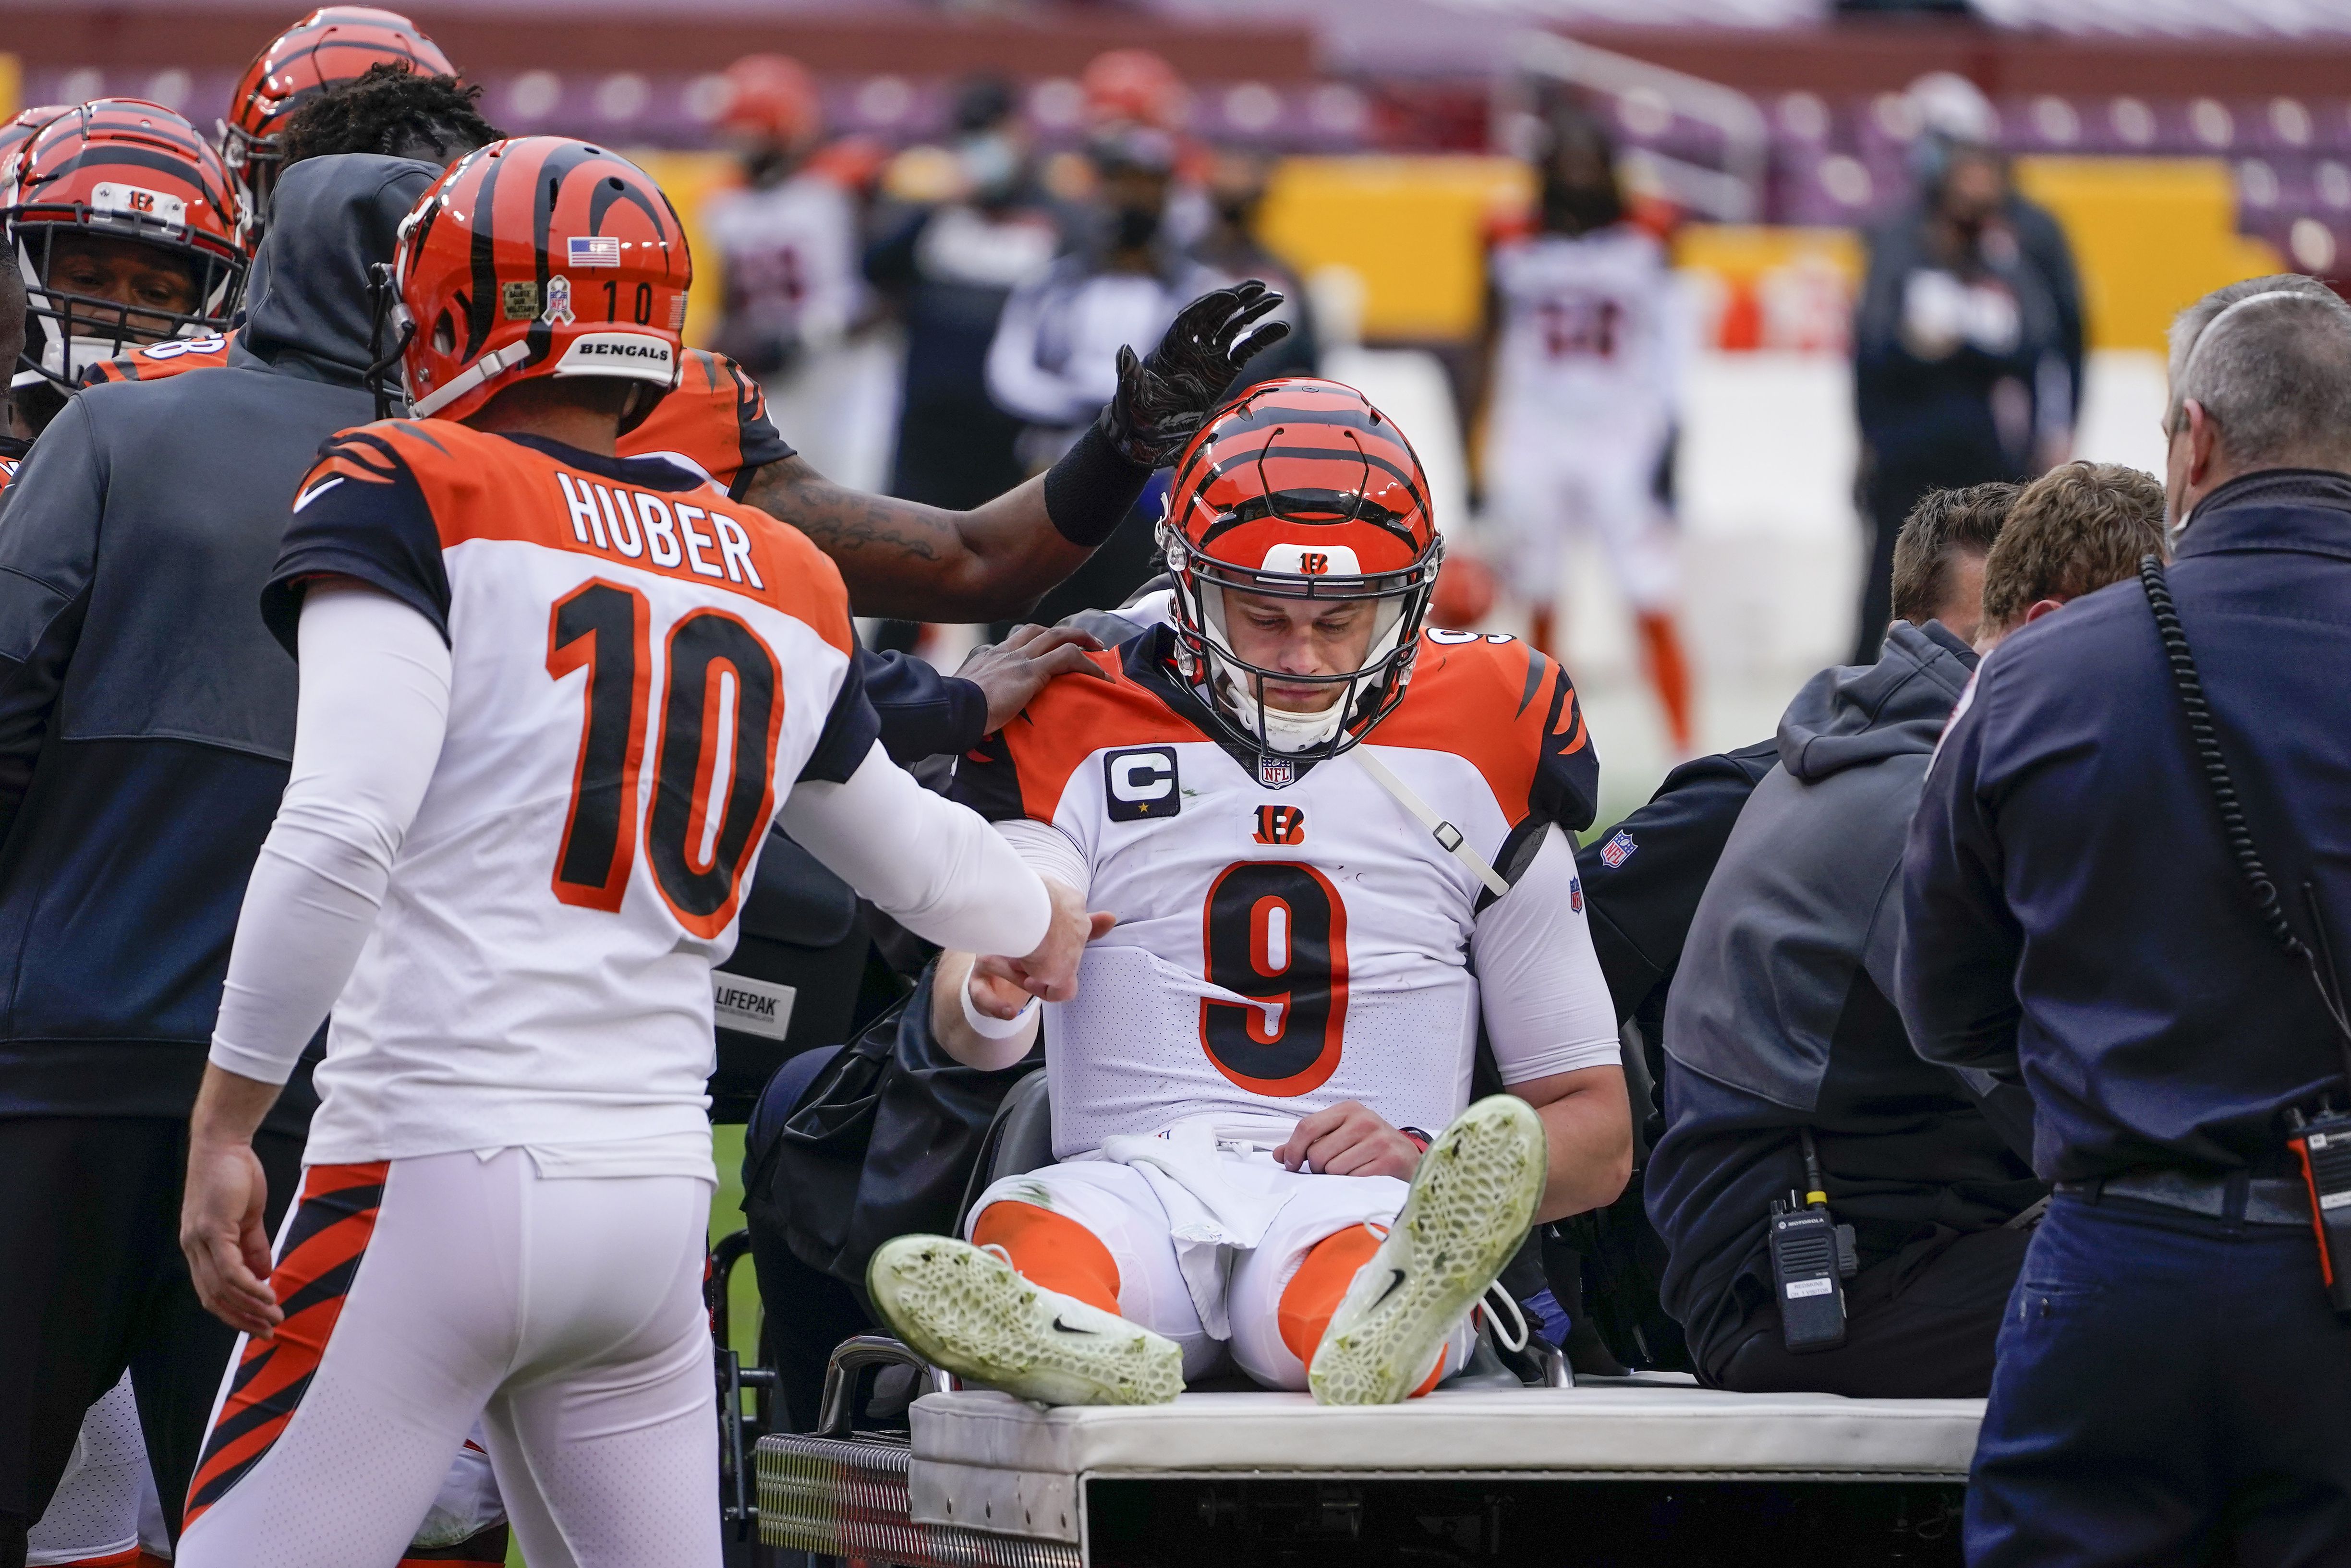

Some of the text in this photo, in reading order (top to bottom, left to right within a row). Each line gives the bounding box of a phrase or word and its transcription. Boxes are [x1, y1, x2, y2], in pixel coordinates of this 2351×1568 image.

[551, 299, 567, 310] NFL
[603, 280, 652, 326] 10
[580, 343, 668, 361] BENGALS
[555, 470, 765, 591] HUBER
[545, 576, 785, 940] 10
[1111, 752, 1173, 802] C
[1264, 768, 1289, 782] NFL
[1252, 805, 1305, 845] B
[1604, 842, 1625, 865] NFL
[1572, 891, 1582, 909] NFL
[1199, 860, 1349, 1097] 9
[715, 986, 776, 1015] LIFEPAK
[1788, 1218, 1824, 1227] MOTOROLA
